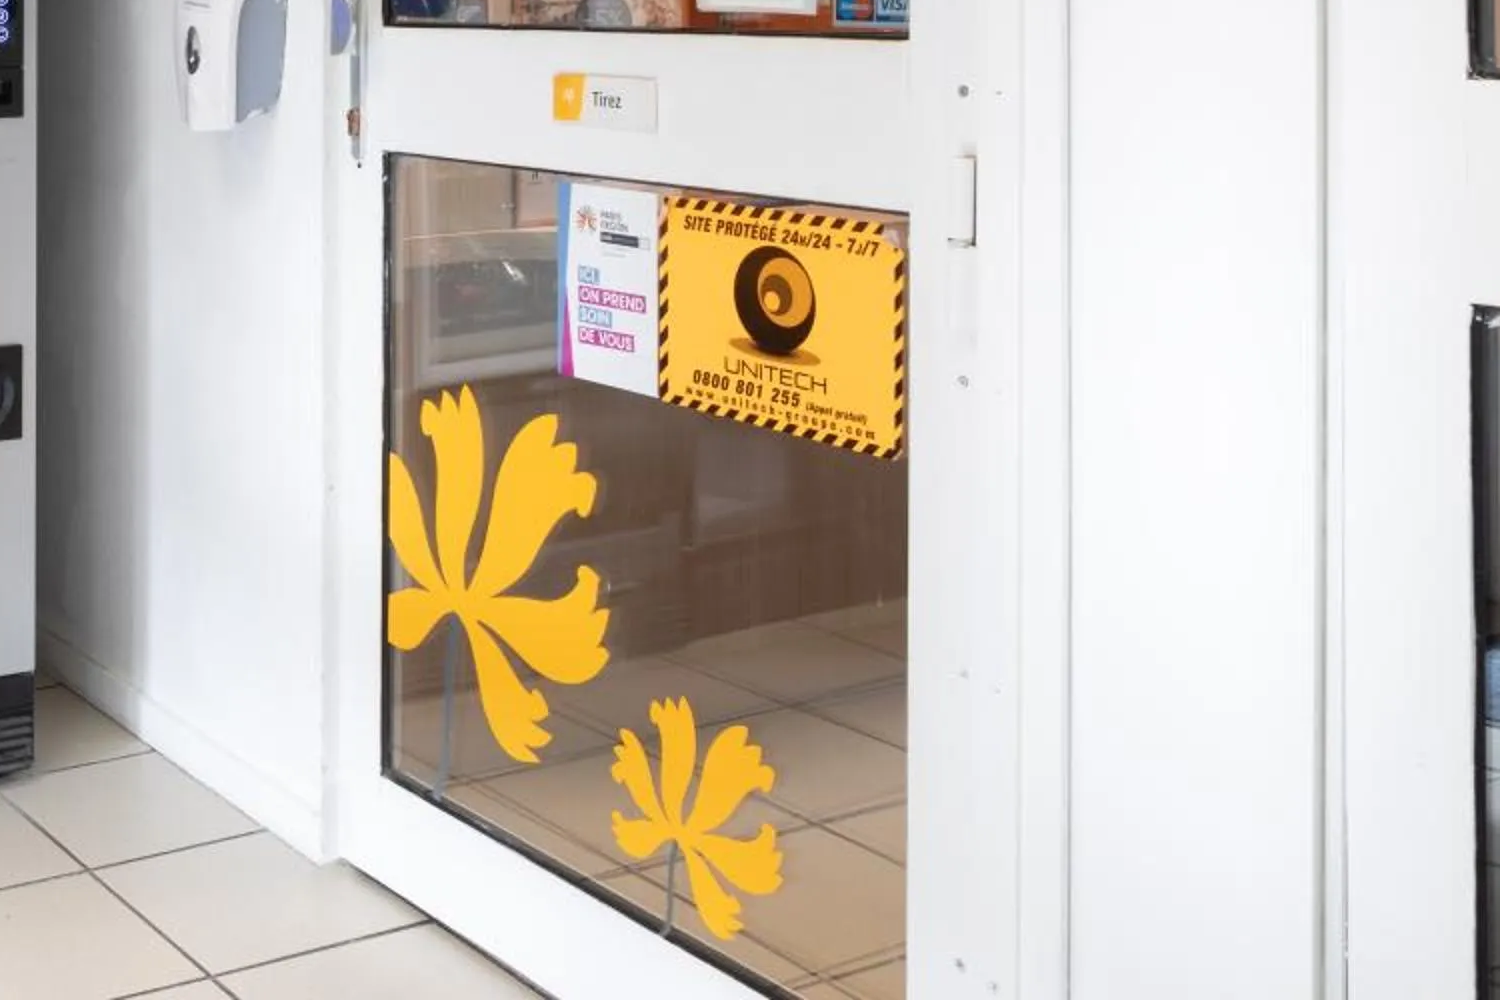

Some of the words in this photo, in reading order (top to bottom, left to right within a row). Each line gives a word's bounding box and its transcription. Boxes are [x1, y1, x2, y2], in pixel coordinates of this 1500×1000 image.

[592, 91, 623, 109] Tirez
[683, 215, 712, 233] SITE
[715, 218, 778, 243] PROTÉGÉ
[580, 287, 599, 303] ON
[602, 291, 645, 312] PREND
[599, 330, 633, 351] VOUS
[693, 369, 730, 391] 0800
[735, 379, 763, 399] 801
[771, 387, 800, 408] 255
[723, 356, 828, 396] UNITECH
